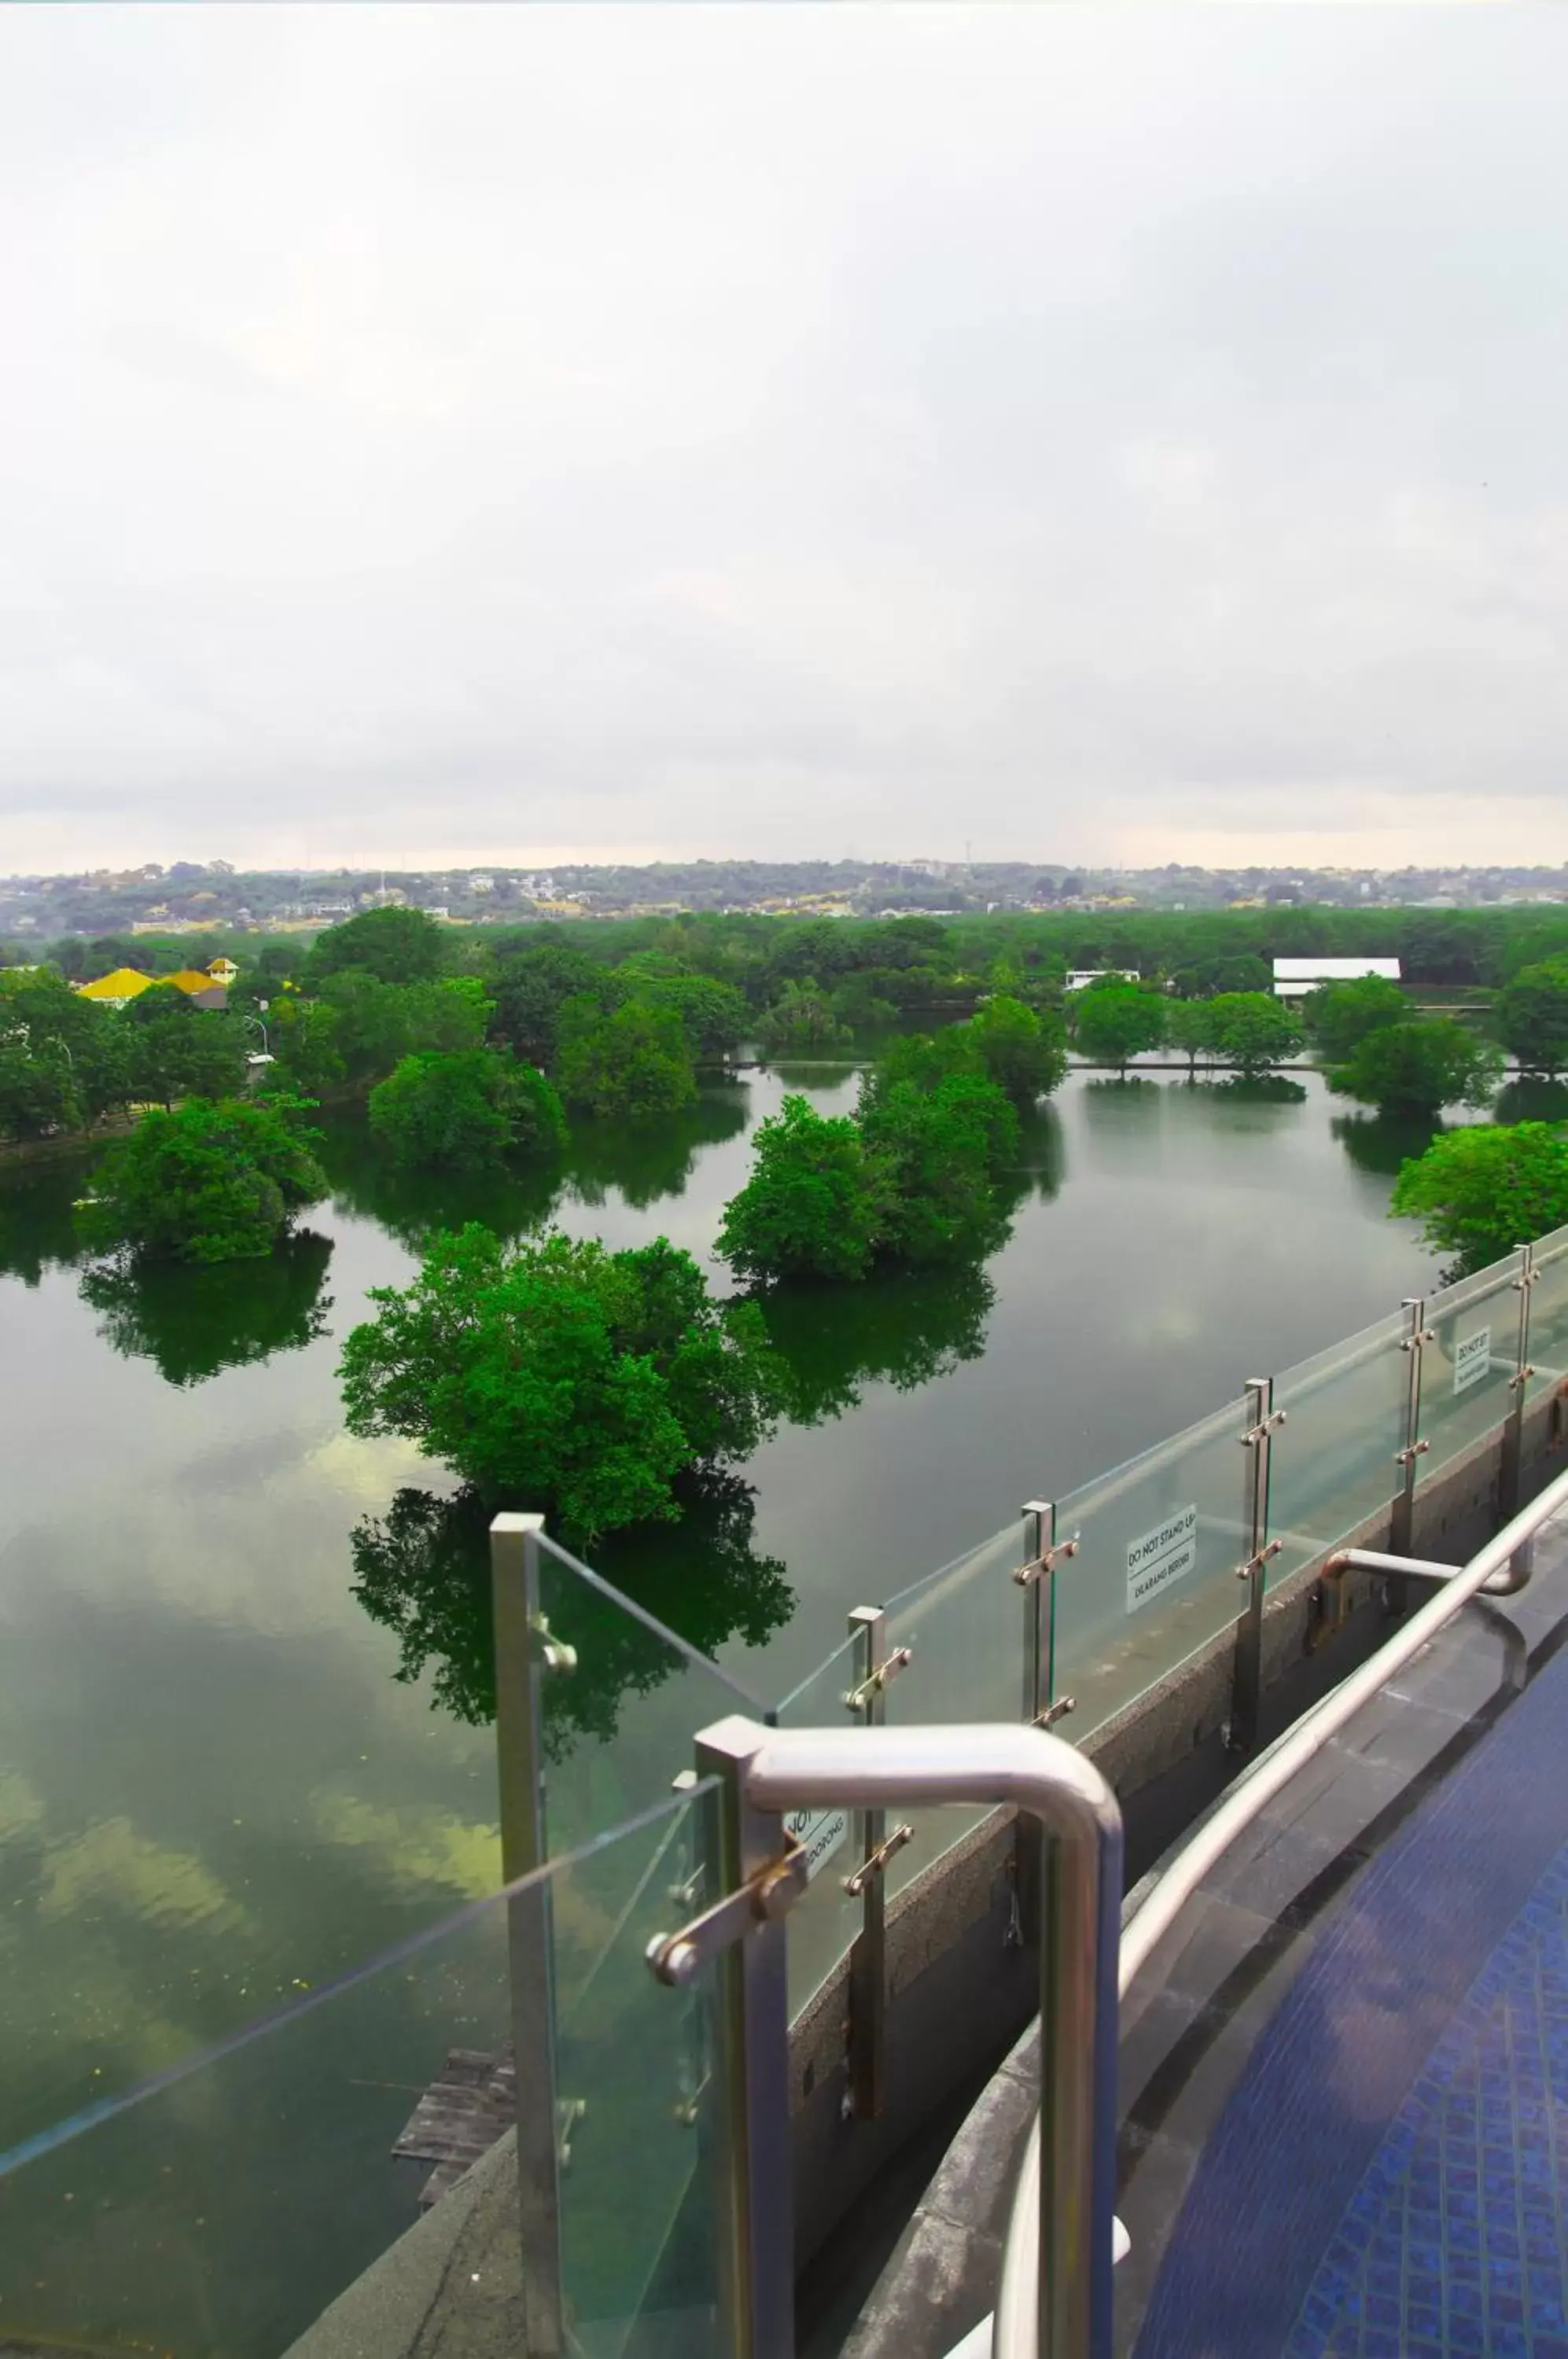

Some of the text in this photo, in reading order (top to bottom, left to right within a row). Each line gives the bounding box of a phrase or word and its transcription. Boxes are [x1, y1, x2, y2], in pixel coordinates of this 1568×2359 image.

[1128, 1513, 1196, 1566] DO NOT STAND UP
